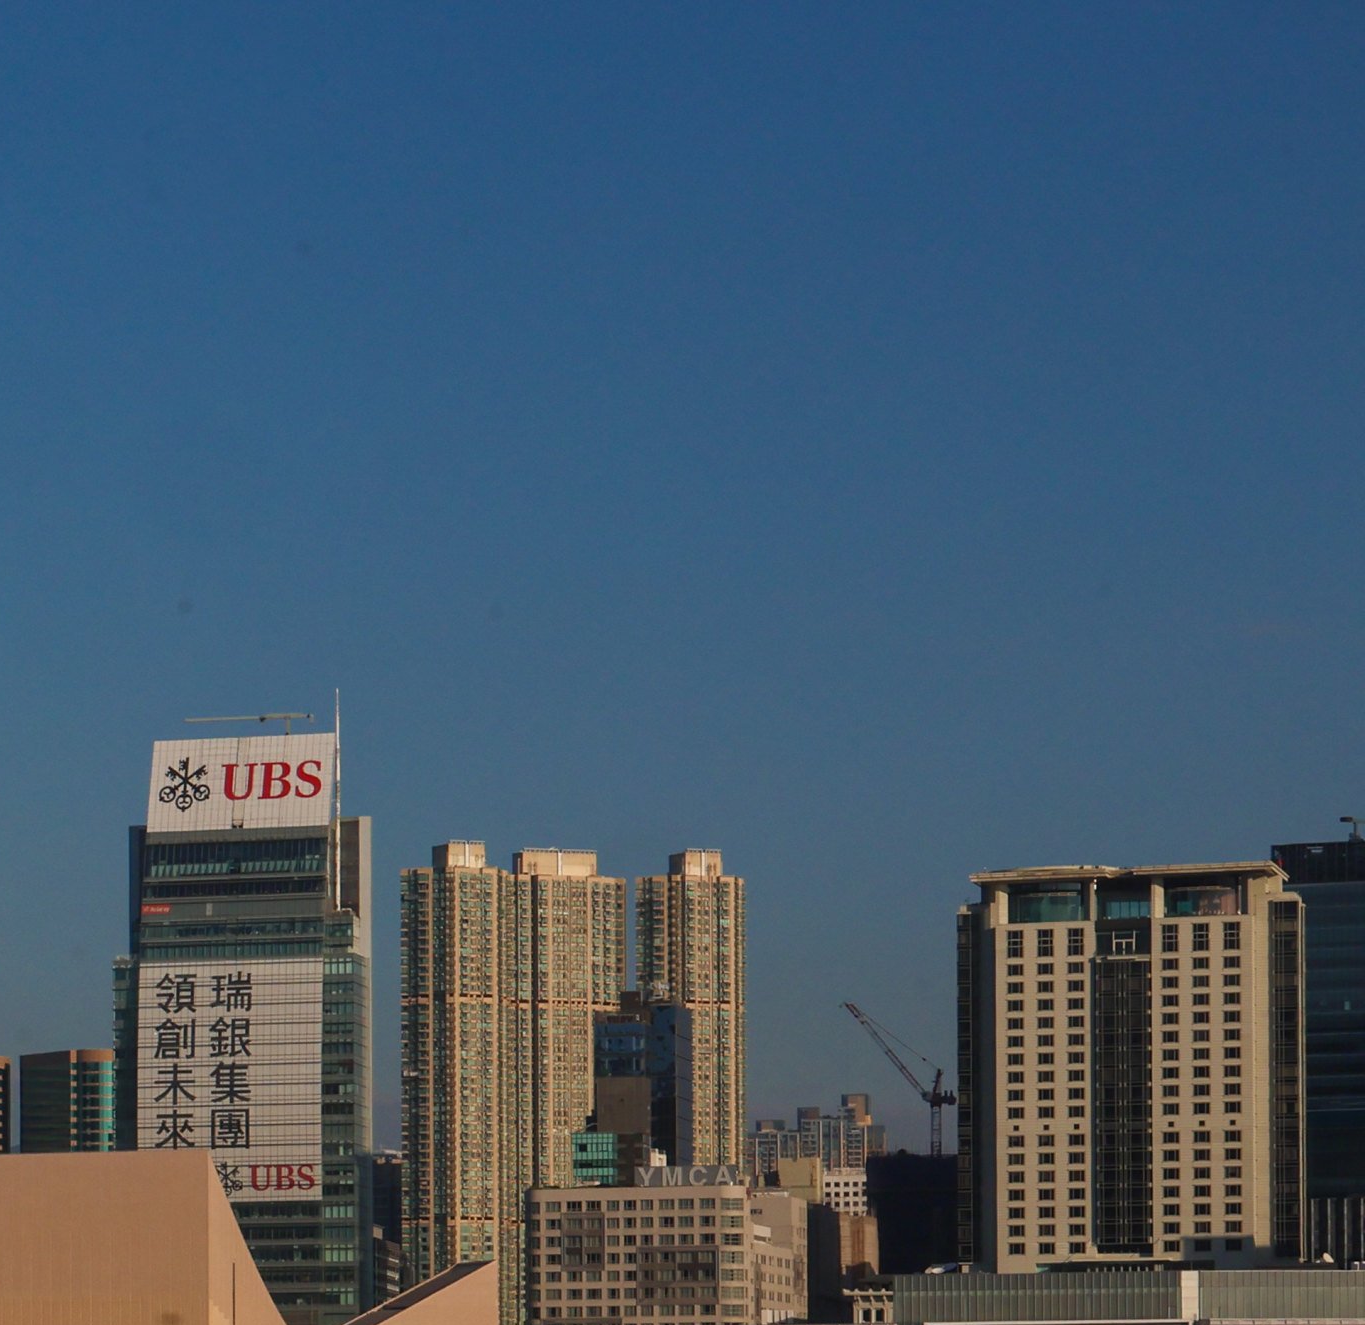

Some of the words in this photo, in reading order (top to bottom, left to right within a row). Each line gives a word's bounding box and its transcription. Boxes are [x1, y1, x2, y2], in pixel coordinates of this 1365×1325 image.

[221, 760, 322, 801] UBS
[153, 973, 197, 1150] 領創未來
[209, 971, 252, 1150] 瑞銀集團
[248, 1164, 316, 1192] UBS
[637, 1165, 733, 1187] YMCA
